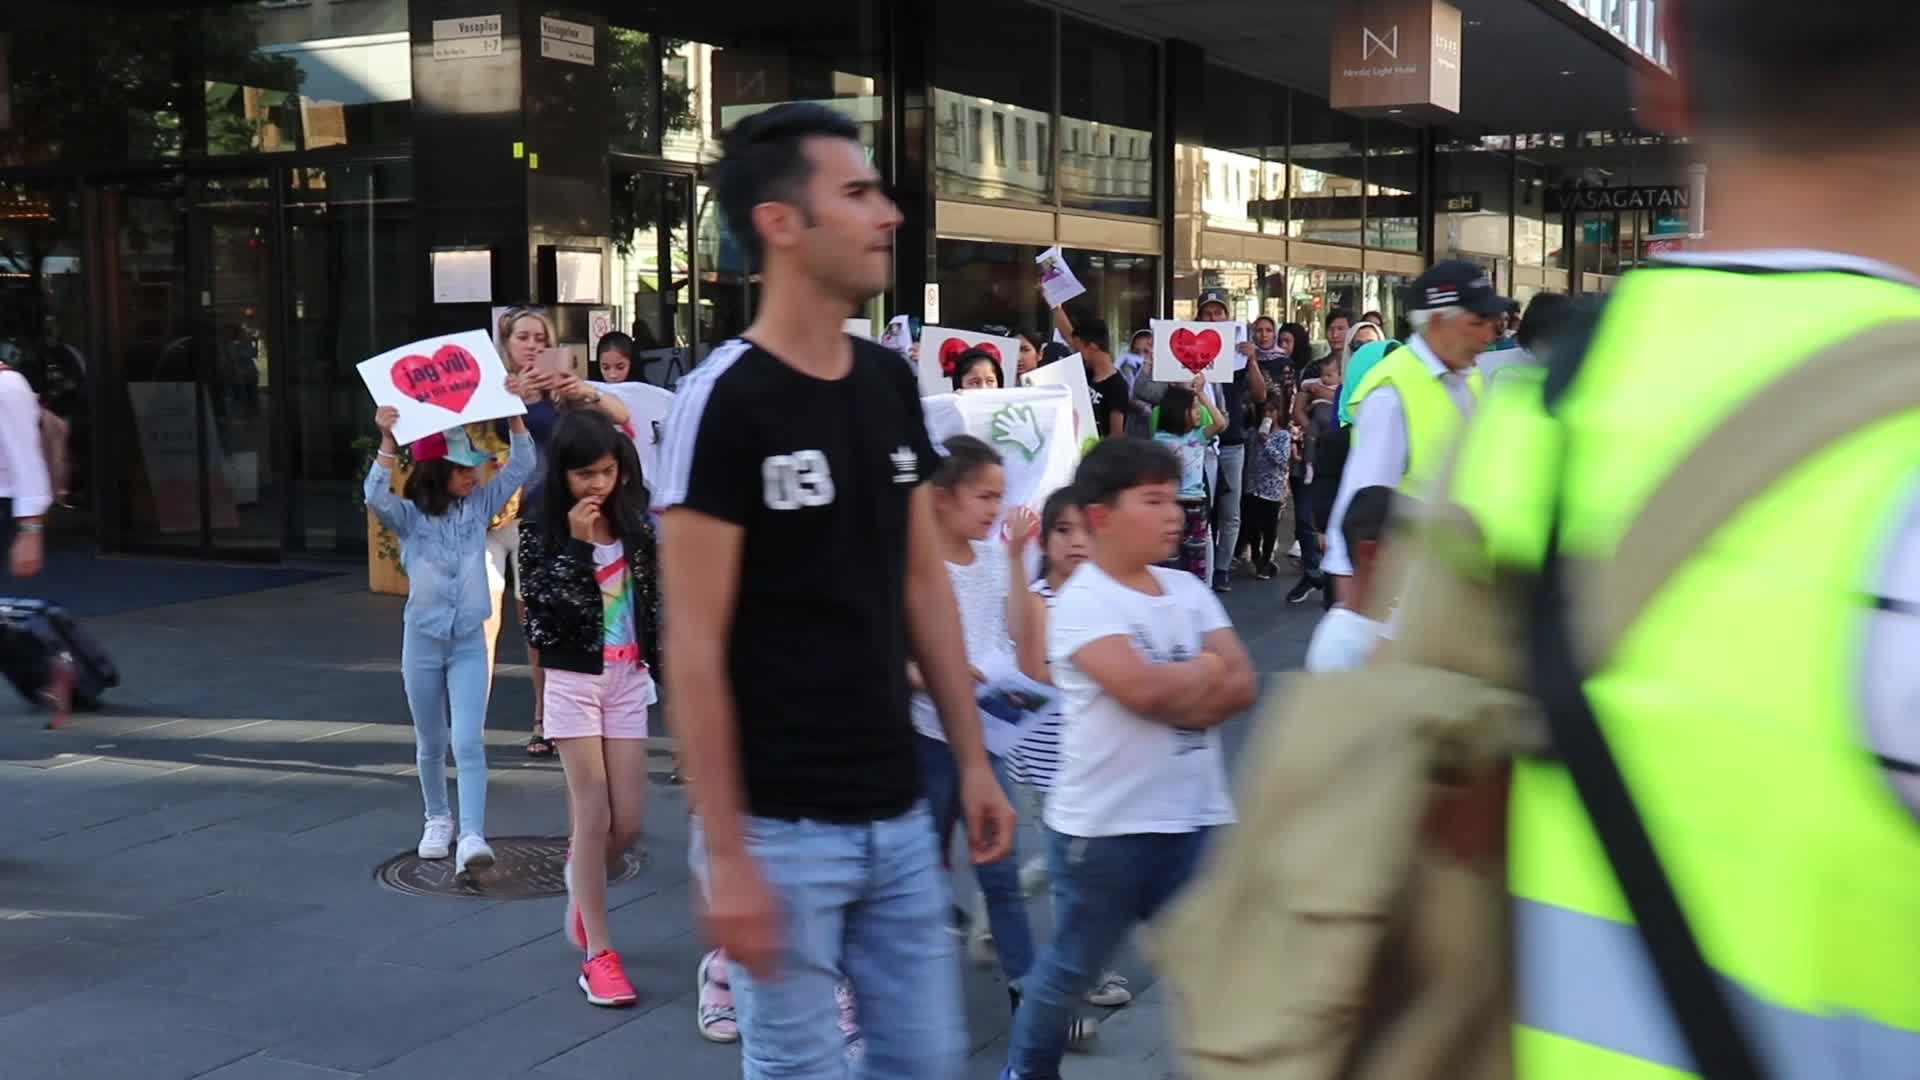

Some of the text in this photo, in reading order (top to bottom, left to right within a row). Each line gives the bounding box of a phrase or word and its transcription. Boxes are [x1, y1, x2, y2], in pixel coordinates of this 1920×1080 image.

[459, 19, 499, 34] Vasaplan
[1560, 188, 1689, 209] VASAGATAN
[403, 351, 470, 389] jag vill
[761, 449, 836, 511] 03
